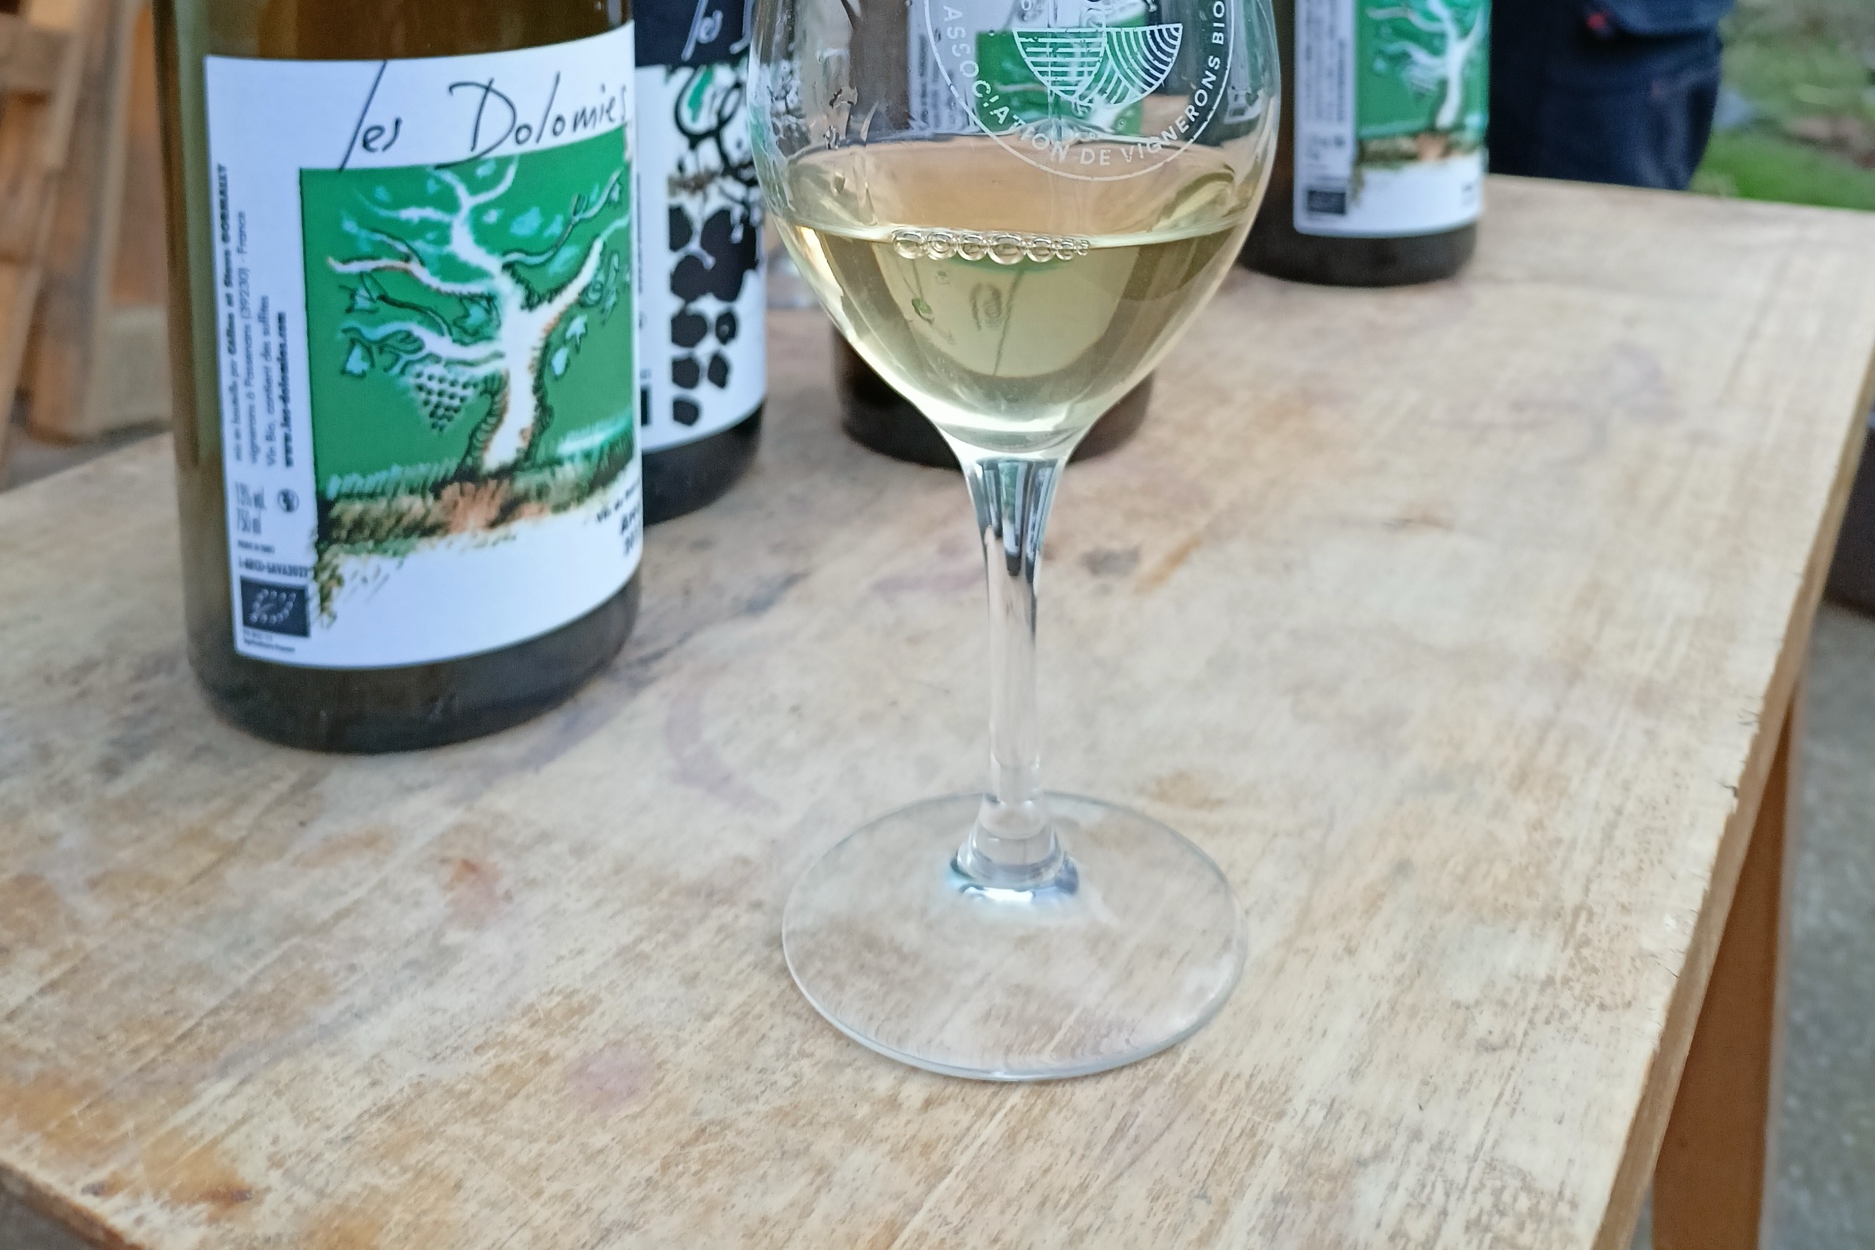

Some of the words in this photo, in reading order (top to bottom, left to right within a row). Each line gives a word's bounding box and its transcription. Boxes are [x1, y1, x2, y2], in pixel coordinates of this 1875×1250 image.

[943, 4, 1070, 162] ASSOCIATION
[1080, 147, 1111, 166] DE
[1120, 56, 1221, 164] VIGNERONS
[1211, 0, 1226, 46] BIO
[337, 61, 404, 173] les
[434, 70, 627, 171] Dolomies
[236, 211, 248, 255] France
[237, 268, 252, 320] (39230)
[243, 324, 255, 388] Passenans
[259, 341, 271, 362] des
[263, 366, 275, 415] contient
[247, 404, 260, 465] vignerons
[265, 446, 277, 467] Vin
